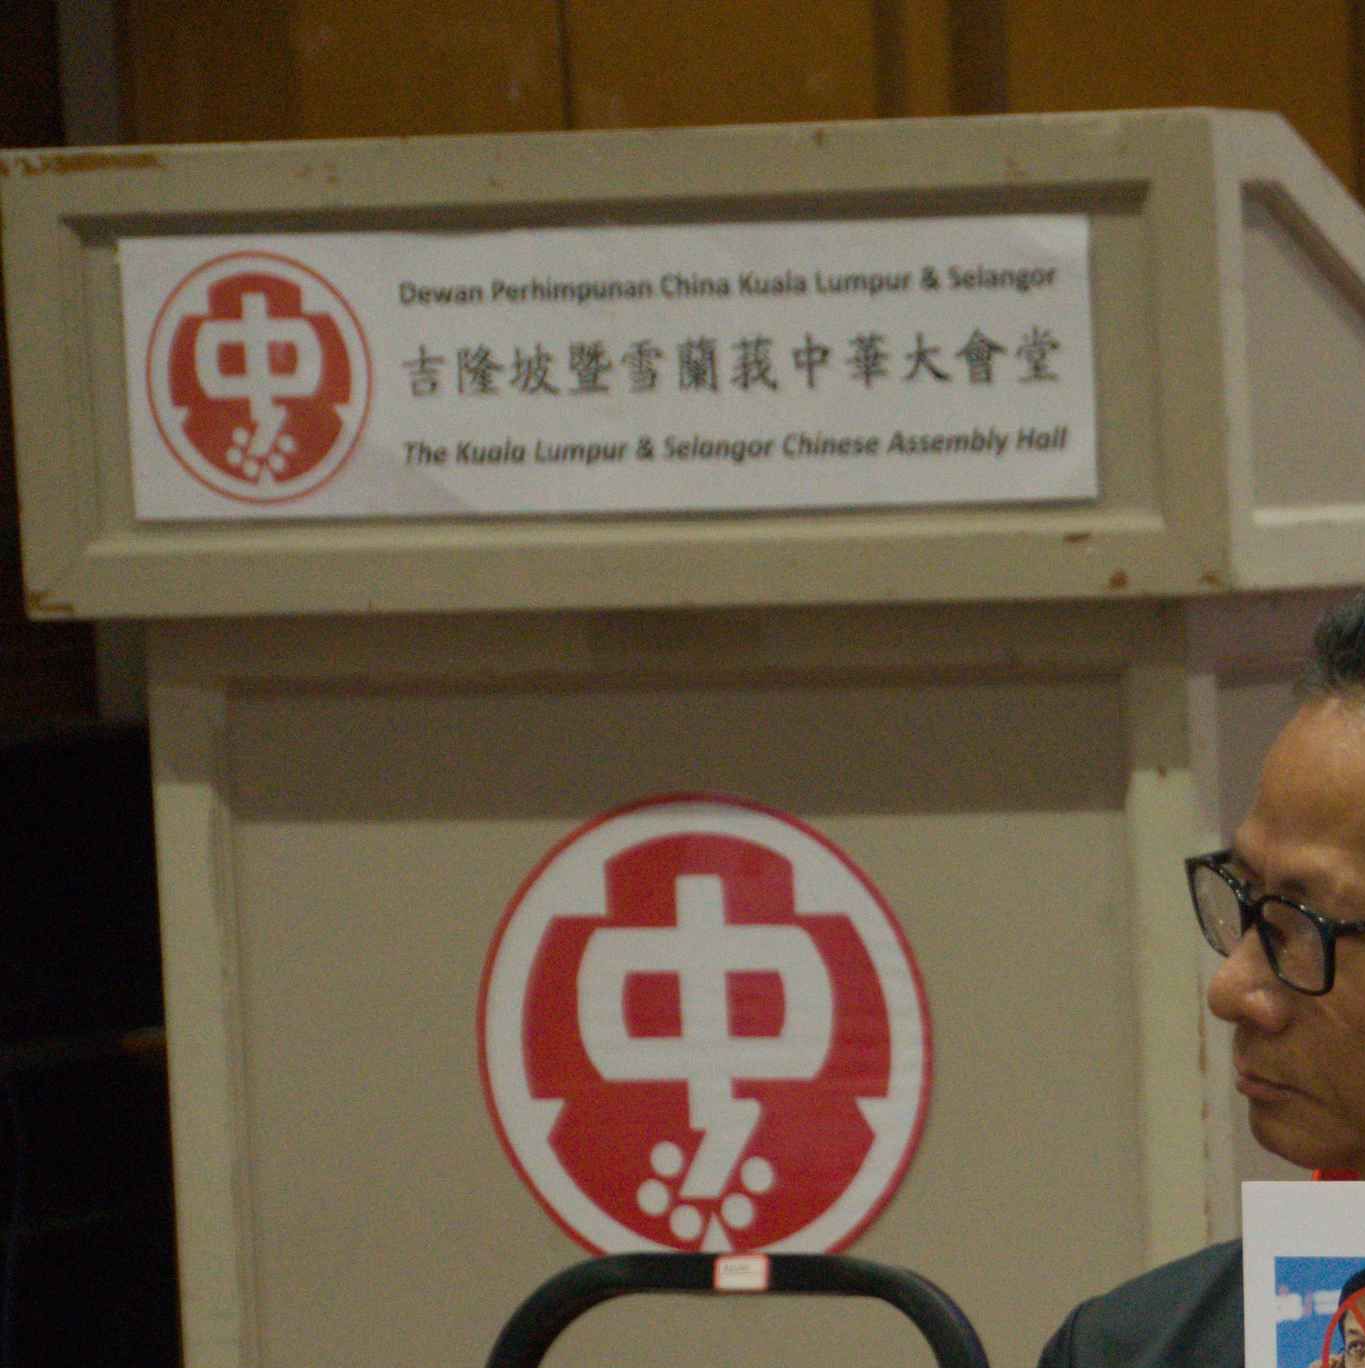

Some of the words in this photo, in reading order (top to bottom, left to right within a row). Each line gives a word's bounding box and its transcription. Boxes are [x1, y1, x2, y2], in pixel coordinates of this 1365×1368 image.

[399, 283, 483, 305] Dewan
[492, 280, 653, 305] Perhimpunan
[660, 275, 731, 299] China
[738, 272, 808, 296] Kuala
[815, 273, 911, 296] Lumpur
[921, 267, 940, 290] &
[946, 267, 1056, 293] Selangor
[402, 326, 1061, 397] 吉隆坡暨雪蘭莪中華大會堂
[403, 442, 448, 465] The
[456, 441, 526, 465] Kuala
[534, 441, 627, 465] Lumpur
[636, 438, 654, 460] &
[662, 436, 774, 464] Selangor
[782, 434, 880, 458] Chinese
[887, 429, 1008, 456] Assembly
[1016, 427, 1068, 451] Hall
